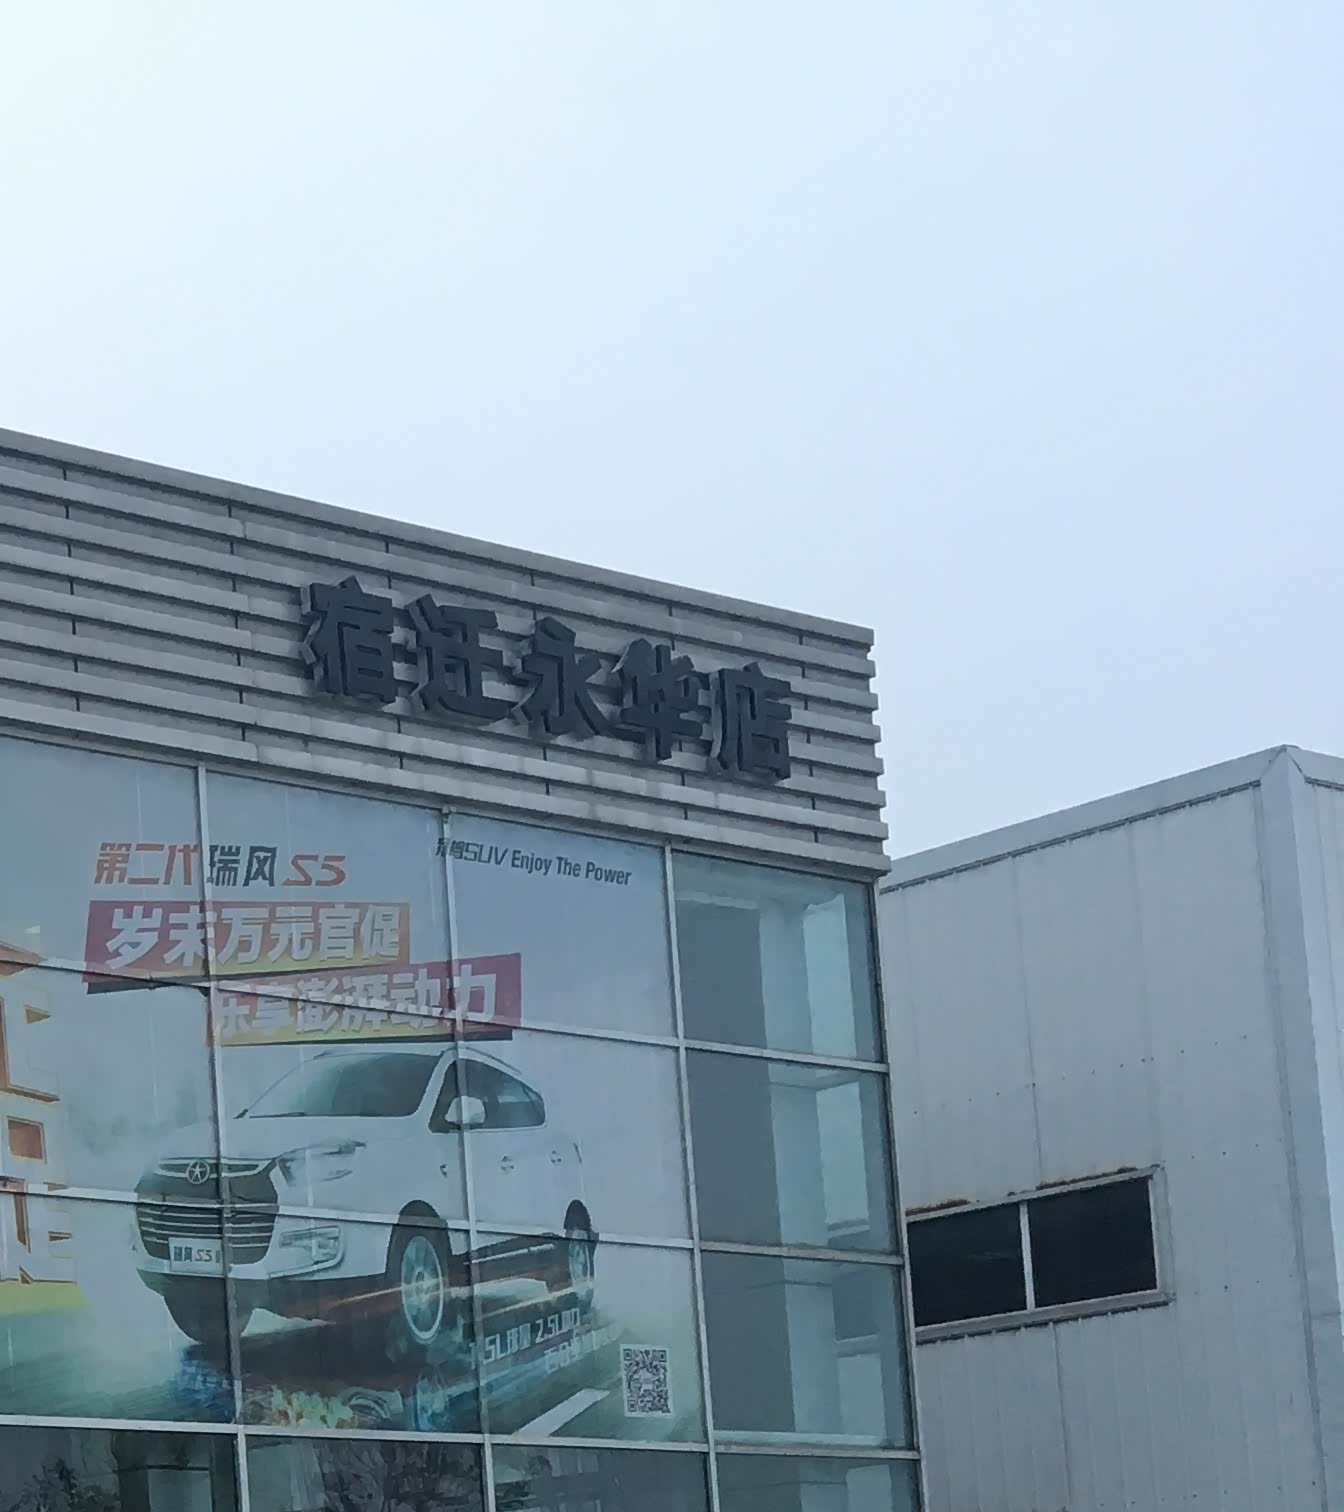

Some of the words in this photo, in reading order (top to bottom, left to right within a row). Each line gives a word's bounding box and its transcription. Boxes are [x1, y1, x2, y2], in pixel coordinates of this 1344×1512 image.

[302, 576, 791, 780] 宿迁永华店
[511, 849, 553, 876] Enjoy
[556, 855, 582, 878] The
[585, 861, 632, 886] Power
[104, 902, 402, 970] 岁末万元官促
